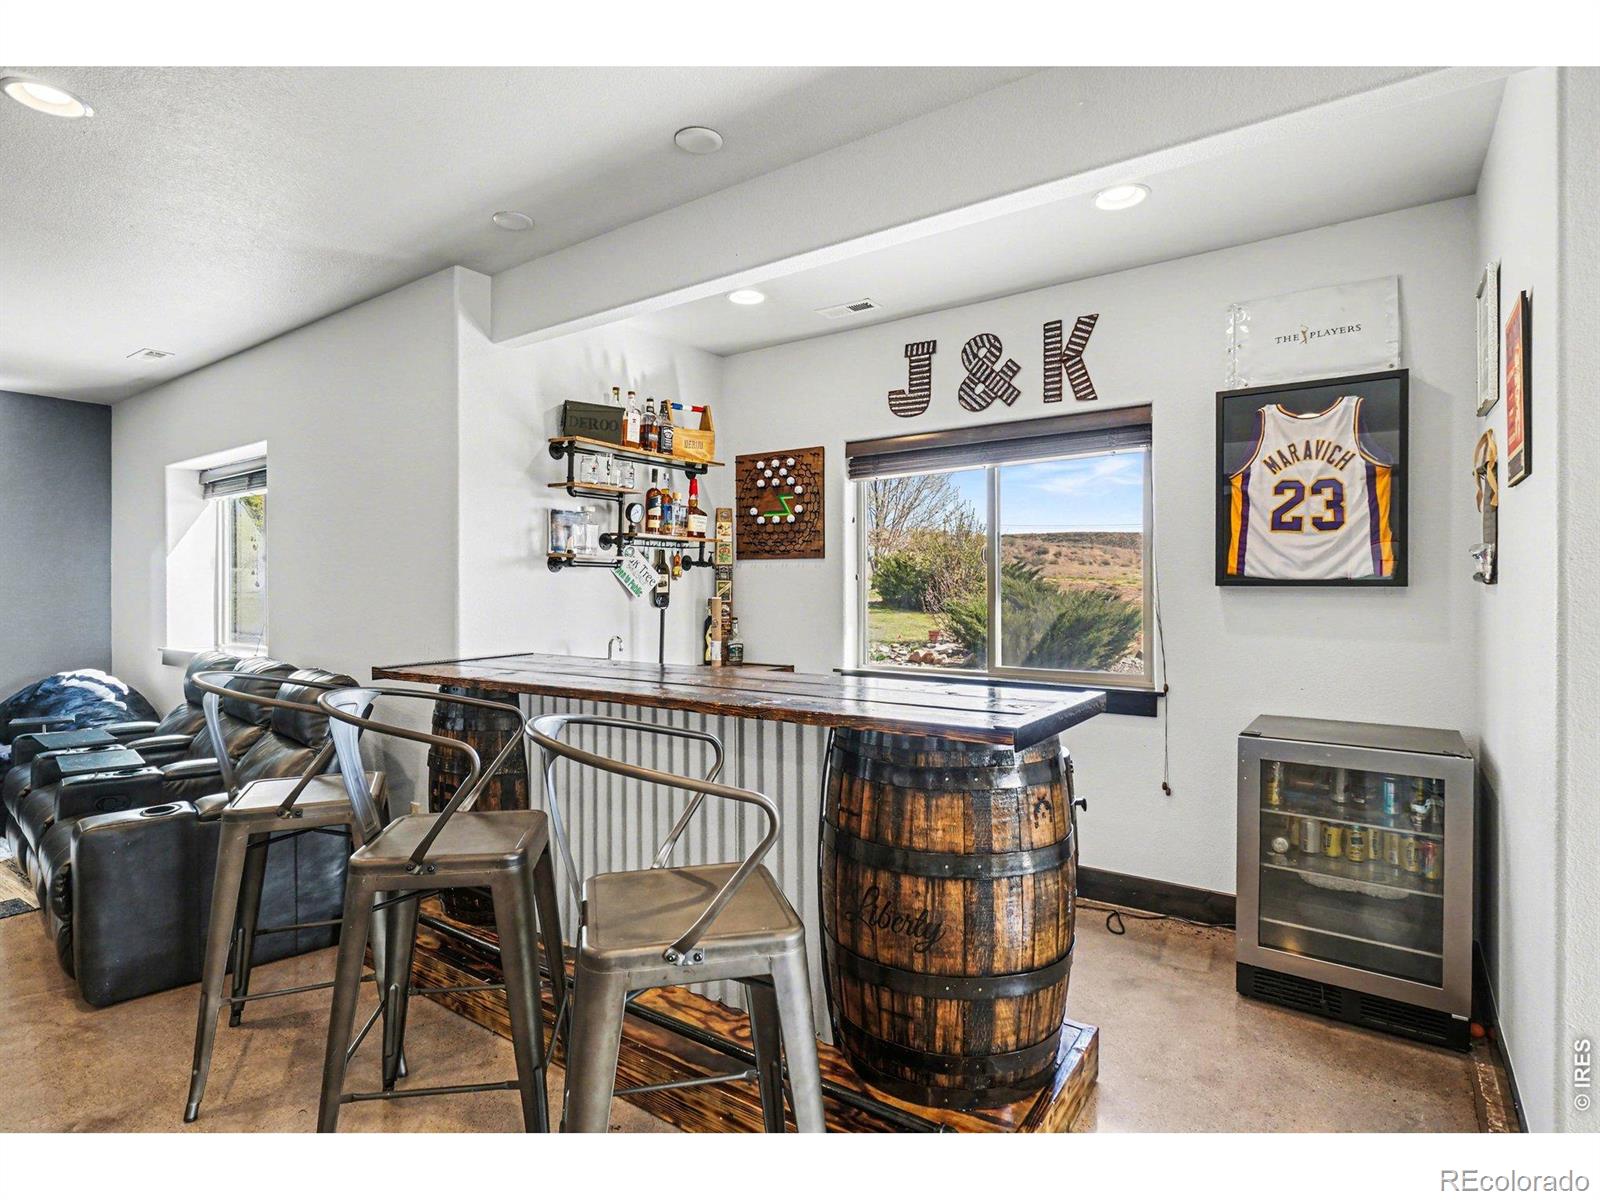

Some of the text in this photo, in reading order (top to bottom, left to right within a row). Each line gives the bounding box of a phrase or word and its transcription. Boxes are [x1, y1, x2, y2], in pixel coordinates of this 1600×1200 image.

[1274, 323, 1362, 345] THE PLAYERS
[888, 313, 1099, 418] J & K
[1262, 439, 1357, 475] MARAVICH
[1270, 477, 1346, 533] 23
[639, 564, 657, 587] Tree
[845, 885, 946, 953] Liberty
